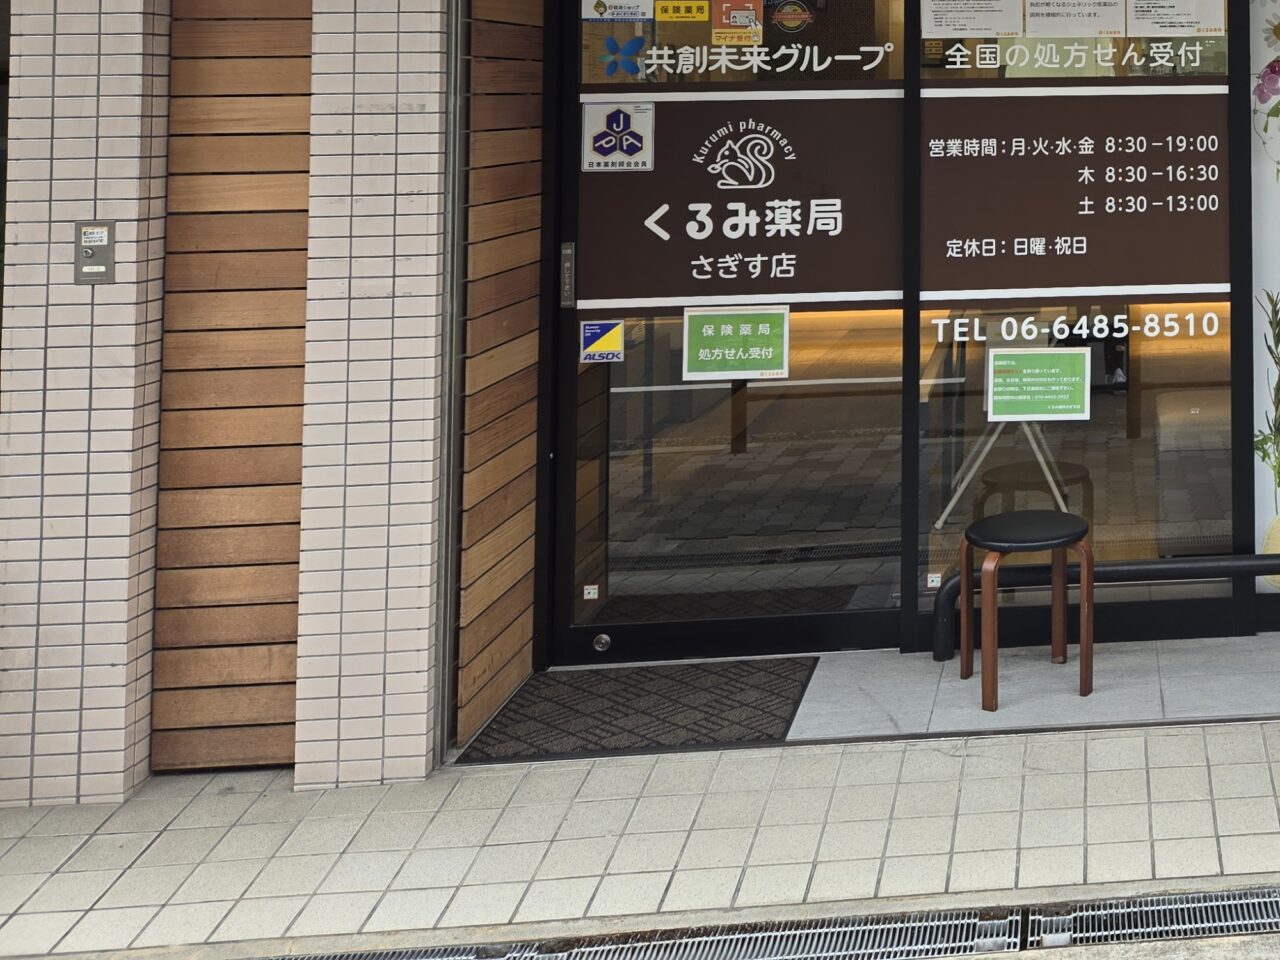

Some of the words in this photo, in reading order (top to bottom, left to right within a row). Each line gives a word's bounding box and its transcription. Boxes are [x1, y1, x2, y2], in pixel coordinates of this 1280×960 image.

[661, 5, 705, 16] 保険薬局
[645, 41, 895, 75] 共創未来グループ
[944, 41, 1204, 69] 全国の処方せん受付
[692, 121, 733, 164] Kurumi
[739, 118, 797, 161] pharmacy
[588, 161, 647, 169] 日本薬剤師会会員
[1078, 166, 1096, 185] 木
[1078, 196, 1096, 215] 土
[644, 198, 844, 241] くるみ薬局
[690, 253, 797, 280] さぎす店
[701, 323, 771, 337] 保険薬局
[931, 317, 988, 343] TEL
[1000, 312, 1220, 340] 06-6485-8510
[583, 352, 622, 361] ALSOK
[698, 347, 774, 361] 処方せん受付
